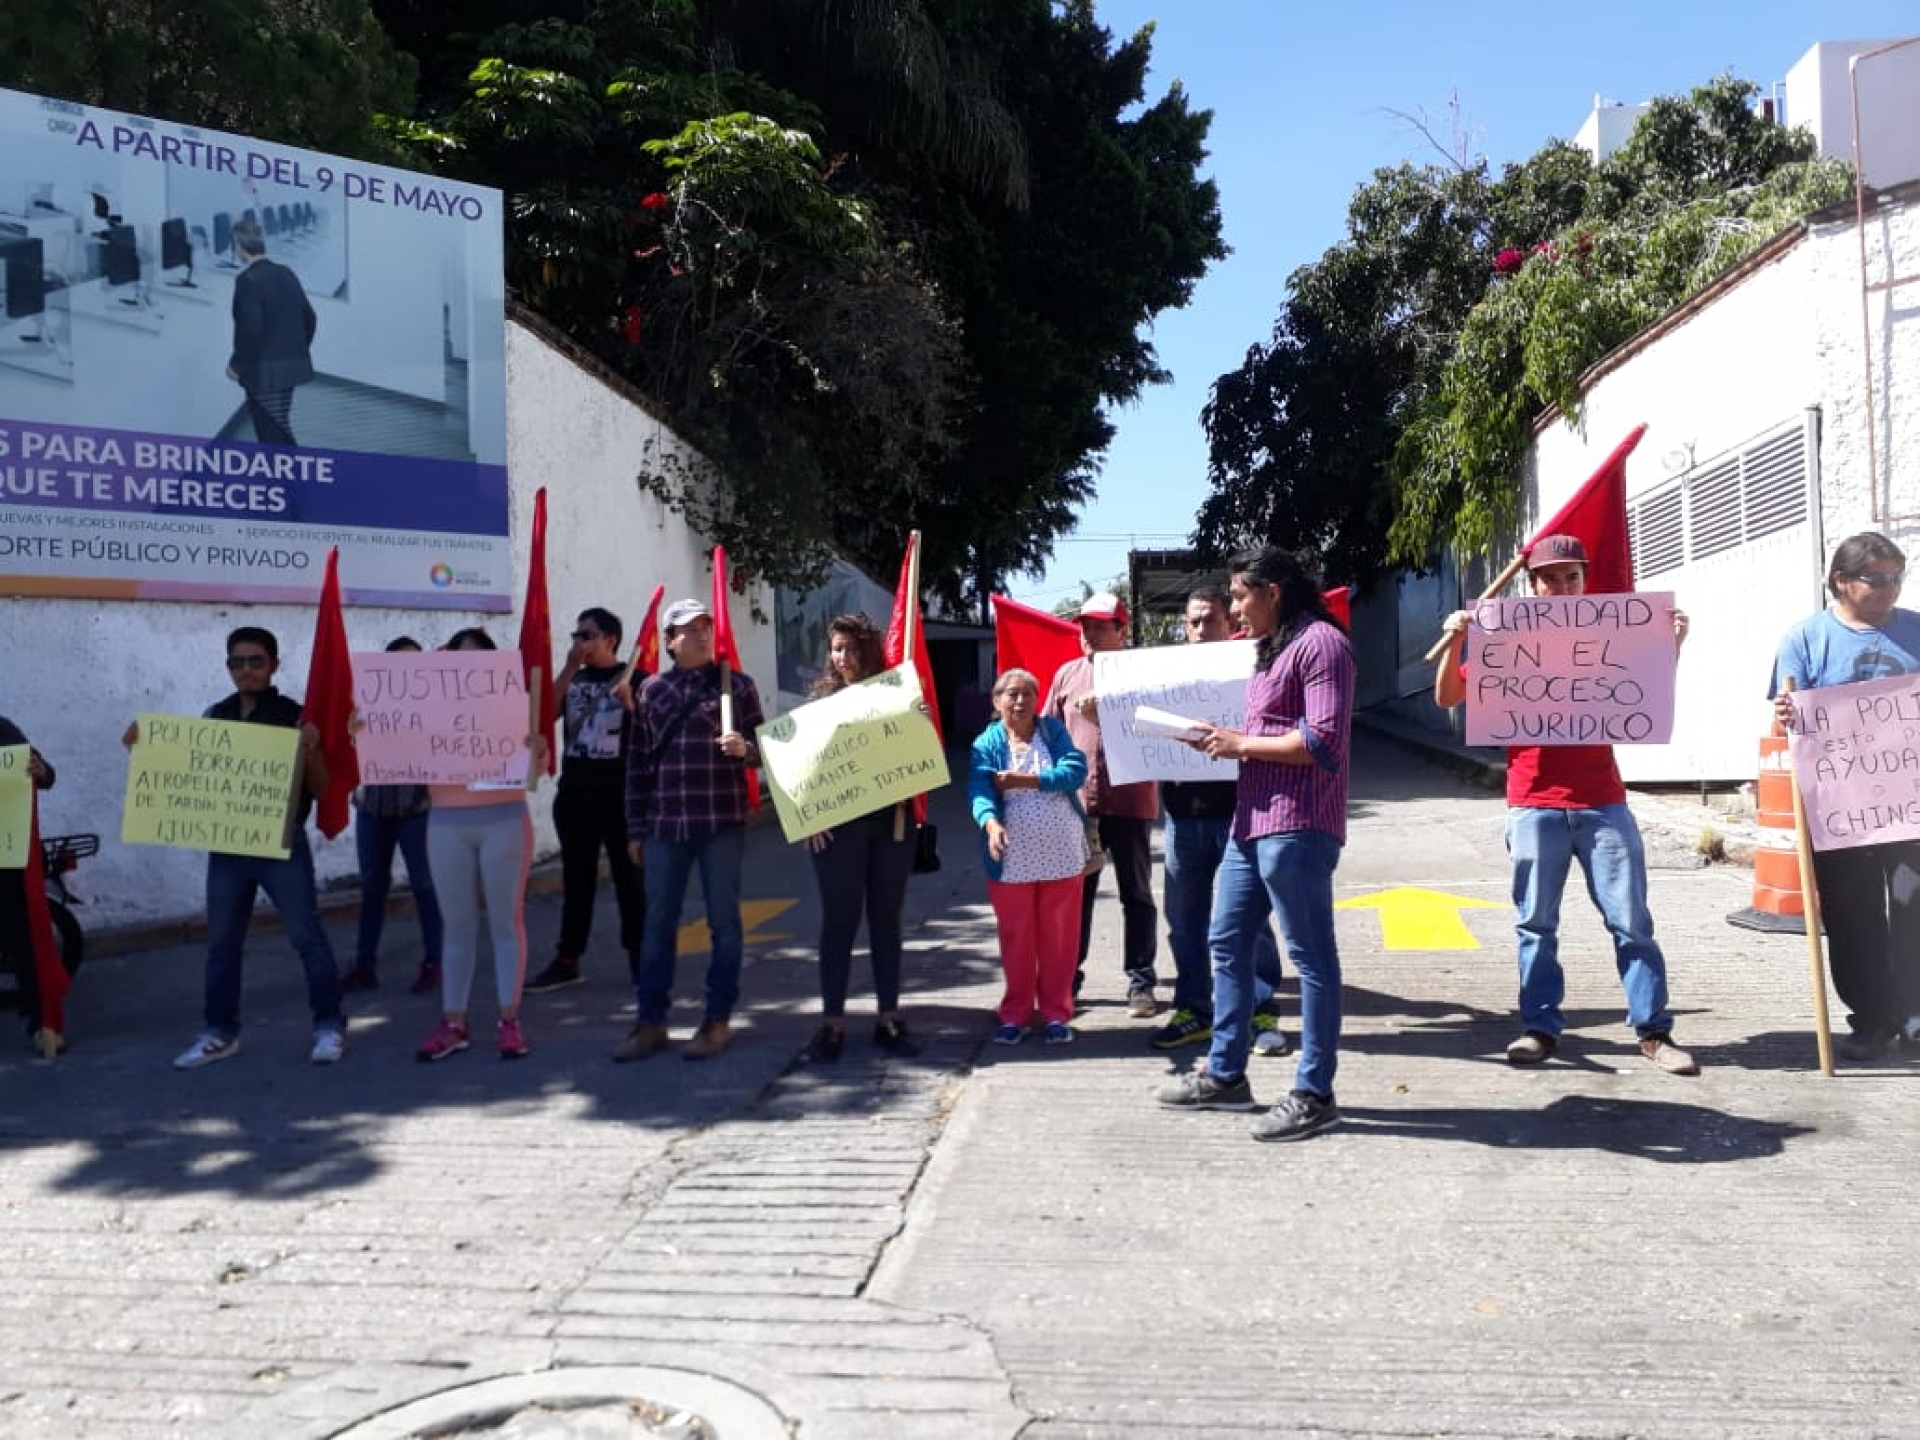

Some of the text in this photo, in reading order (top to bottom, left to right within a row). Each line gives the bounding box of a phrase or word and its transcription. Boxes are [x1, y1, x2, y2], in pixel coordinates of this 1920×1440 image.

[76, 121, 104, 149] A
[113, 126, 237, 175] PARTIR
[247, 152, 310, 189] DEL
[316, 167, 334, 192] 9
[344, 173, 386, 204] DE
[394, 182, 483, 221] MAYO
[21, 431, 126, 466] PARA
[134, 441, 334, 483] BRINDARTE
[0, 466, 286, 512] UE TE MERECES
[45, 515, 53, 526] Y
[56, 516, 115, 529] MEJORES
[119, 520, 214, 534] INSTALACIONES
[71, 535, 181, 563] PÚBLICO
[185, 545, 201, 565] Y
[207, 547, 309, 568] PRIVADO
[1477, 598, 1653, 632] CLARIDAD
[1482, 640, 1627, 671] EN EL
[361, 669, 522, 704] JUSTICIA
[1478, 675, 1644, 706] PROCESO
[367, 711, 483, 735] PARA EL
[1490, 711, 1653, 741] JURIDICO
[1799, 704, 1832, 736] LA
[430, 735, 515, 758] PUEBLO
[190, 749, 289, 781] BORRACHO
[1815, 748, 1919, 783] AYUDA
[136, 770, 233, 794] ATROPELLA
[136, 794, 156, 808] DE
